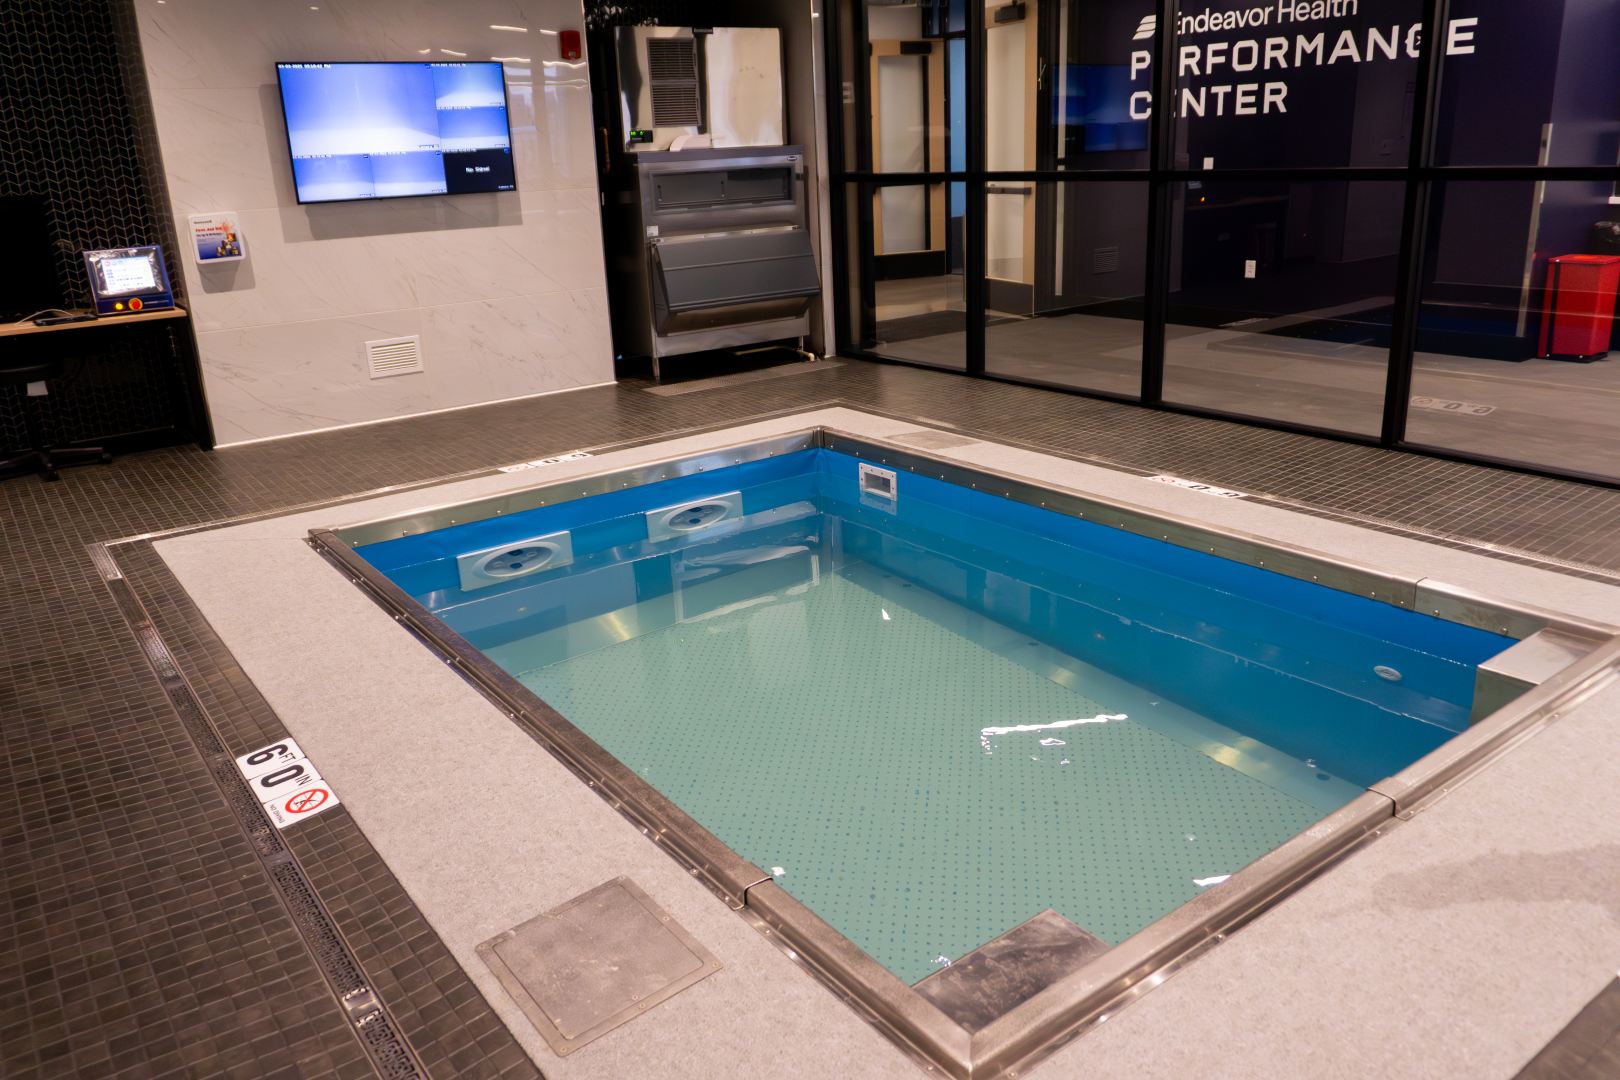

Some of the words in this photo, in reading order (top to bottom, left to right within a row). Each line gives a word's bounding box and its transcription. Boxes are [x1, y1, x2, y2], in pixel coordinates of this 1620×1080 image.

[1277, 0, 1358, 23] Health
[1131, 17, 1479, 80] PRFORMANCE
[1130, 82, 1288, 121] CNTER
[246, 744, 288, 765] 6
[278, 752, 296, 764] FT
[260, 764, 305, 788] 0
[295, 773, 313, 787] IN
